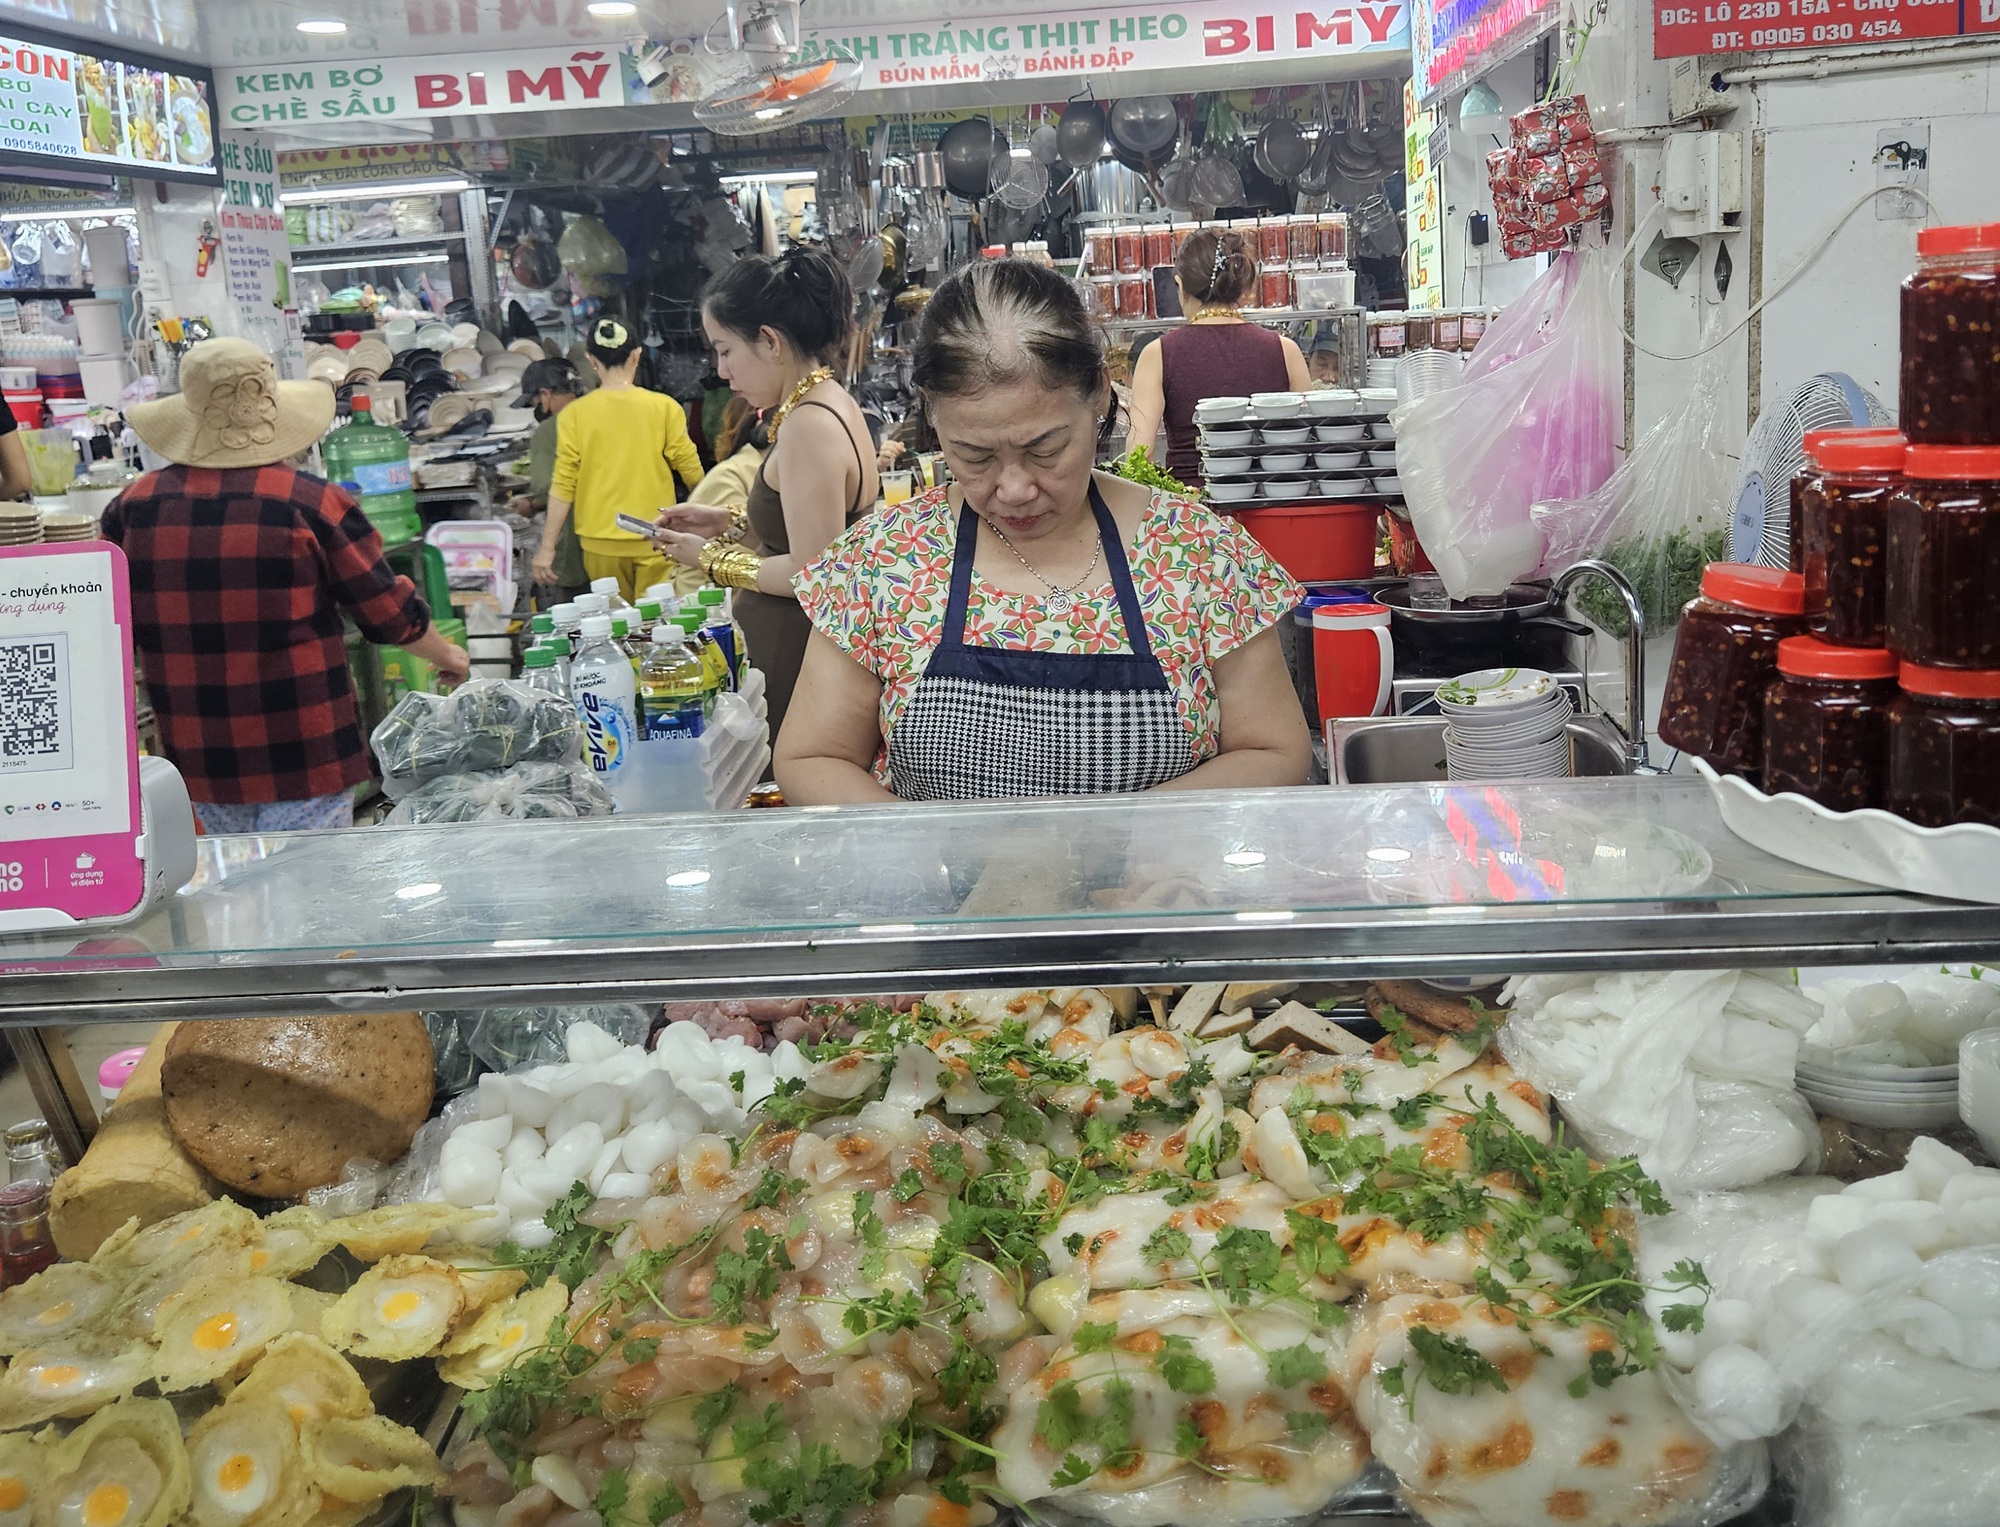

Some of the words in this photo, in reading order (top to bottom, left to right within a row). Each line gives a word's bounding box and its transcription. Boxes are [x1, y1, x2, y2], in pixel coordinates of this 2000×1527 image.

[1661, 8, 1698, 26] ĐC:
[1704, 2, 1731, 23] LÔ
[1738, 1, 1781, 20] 23Đ
[789, 31, 879, 64] ÁNH
[887, 21, 1010, 58] TRÁNG
[1017, 19, 1100, 55] THỊT
[1109, 13, 1188, 43] HEO
[1203, 15, 1275, 57] BI
[1712, 31, 1744, 49] ĐT:
[1750, 26, 1805, 46] 0905
[1812, 23, 1853, 41] 030
[1860, 19, 1903, 38] 454
[236, 72, 315, 94] KEM
[328, 65, 383, 88] BƠ
[414, 71, 488, 109] BI
[507, 50, 612, 104] MỸ
[879, 61, 926, 84] BÚN
[930, 54, 980, 81] MẮM
[1024, 50, 1085, 73] BÁNH
[1090, 46, 1134, 72] ĐẬP
[230, 97, 308, 123] CHÈ
[321, 89, 396, 118] SẦU
[4, 137, 78, 156] 0905840628
[221, 138, 241, 170] HÈ
[246, 138, 274, 174] SẦU
[10, 583, 58, 598] chuyển
[61, 581, 102, 595] khoản
[28, 599, 67, 615] dụng
[649, 727, 693, 741] AQUAFINA
